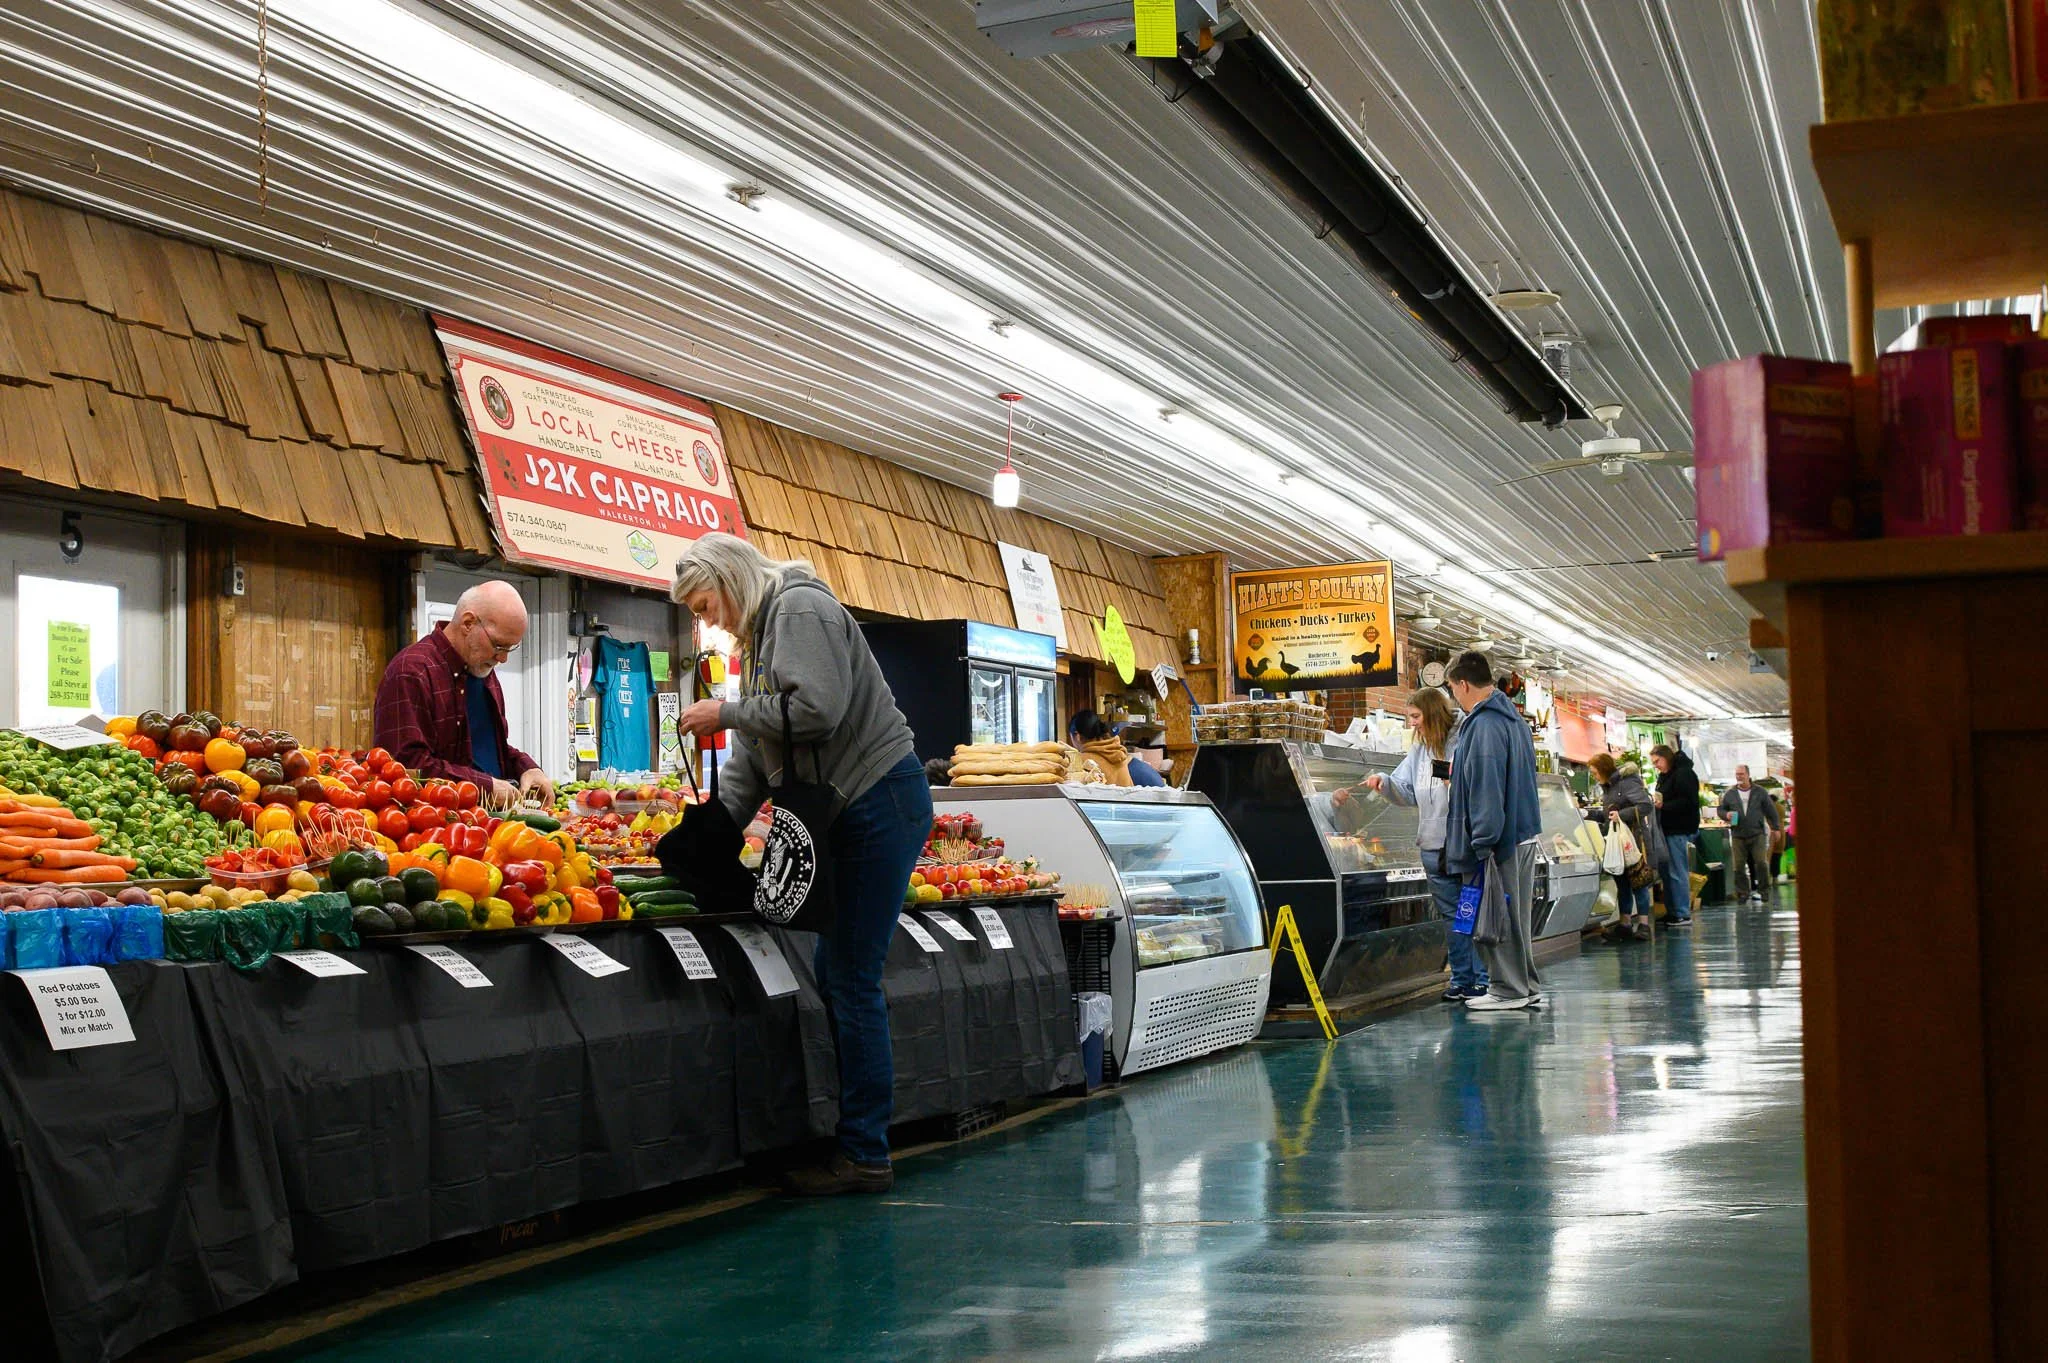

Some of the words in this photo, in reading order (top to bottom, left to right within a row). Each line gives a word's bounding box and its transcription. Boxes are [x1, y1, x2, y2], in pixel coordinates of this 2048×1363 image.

[536, 386, 577, 404] FARMSTEAD
[526, 405, 602, 443] LOCAL
[611, 430, 687, 467] CHEESE
[538, 434, 602, 459] HANDCRAFTED
[634, 460, 685, 481] ALL-NATURAL
[524, 453, 585, 498] J2K
[590, 472, 720, 530] CAPRAIO
[599, 508, 655, 528] WALKERTON,
[658, 522, 667, 530] IN
[59, 511, 84, 558] 5
[1237, 580, 1304, 615] HIATT'S
[1308, 573, 1386, 604] POULTRY
[1250, 616, 1292, 630] Chickens
[1300, 614, 1329, 627] Ducks
[1337, 611, 1376, 624] Turkeys
[57, 655, 68, 663] For
[567, 651, 577, 682] 7
[61, 667, 79, 676] Please
[52, 679, 63, 687] call
[660, 694, 677, 704] PROUD
[662, 705, 668, 713] TO
[669, 705, 675, 713] BE
[775, 809, 811, 847] RECORDS
[780, 829, 795, 850] TRADE
[555, 940, 586, 949] Peppers
[38, 984, 59, 994] Red
[60, 982, 100, 992] Potatoes
[54, 996, 80, 1007] $5.00
[81, 996, 99, 1004] Box
[57, 1012, 63, 1021] 3
[65, 1012, 77, 1020] for
[79, 1008, 106, 1019] $12.00
[60, 1026, 76, 1035] Mix
[77, 1026, 87, 1034] or
[87, 1022, 113, 1032] Match
